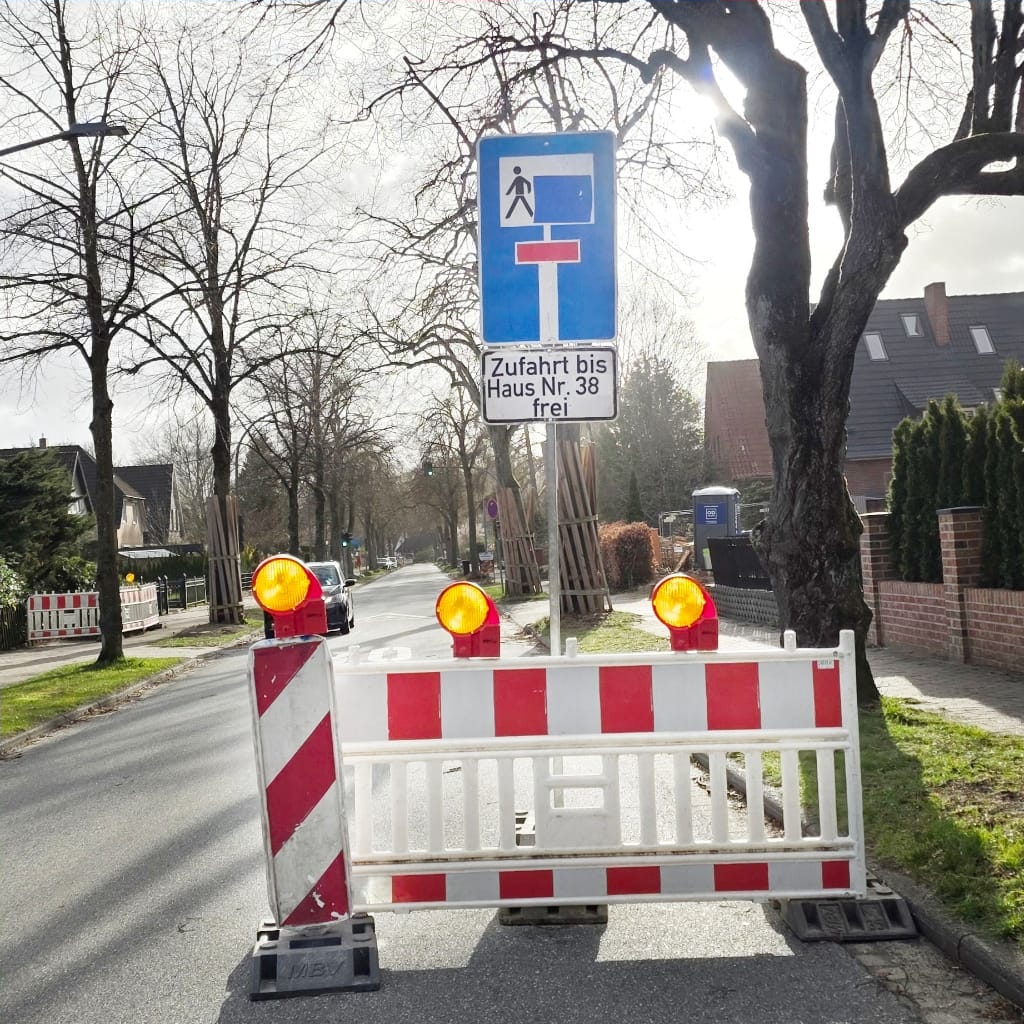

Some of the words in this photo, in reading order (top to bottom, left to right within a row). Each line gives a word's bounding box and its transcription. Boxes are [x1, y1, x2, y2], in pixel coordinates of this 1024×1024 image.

[491, 356, 568, 377] Zufahrt
[576, 354, 607, 374] bis
[487, 378, 535, 398] Haus
[542, 376, 570, 396] Nr.
[575, 376, 599, 395] 38
[533, 397, 568, 417] frei
